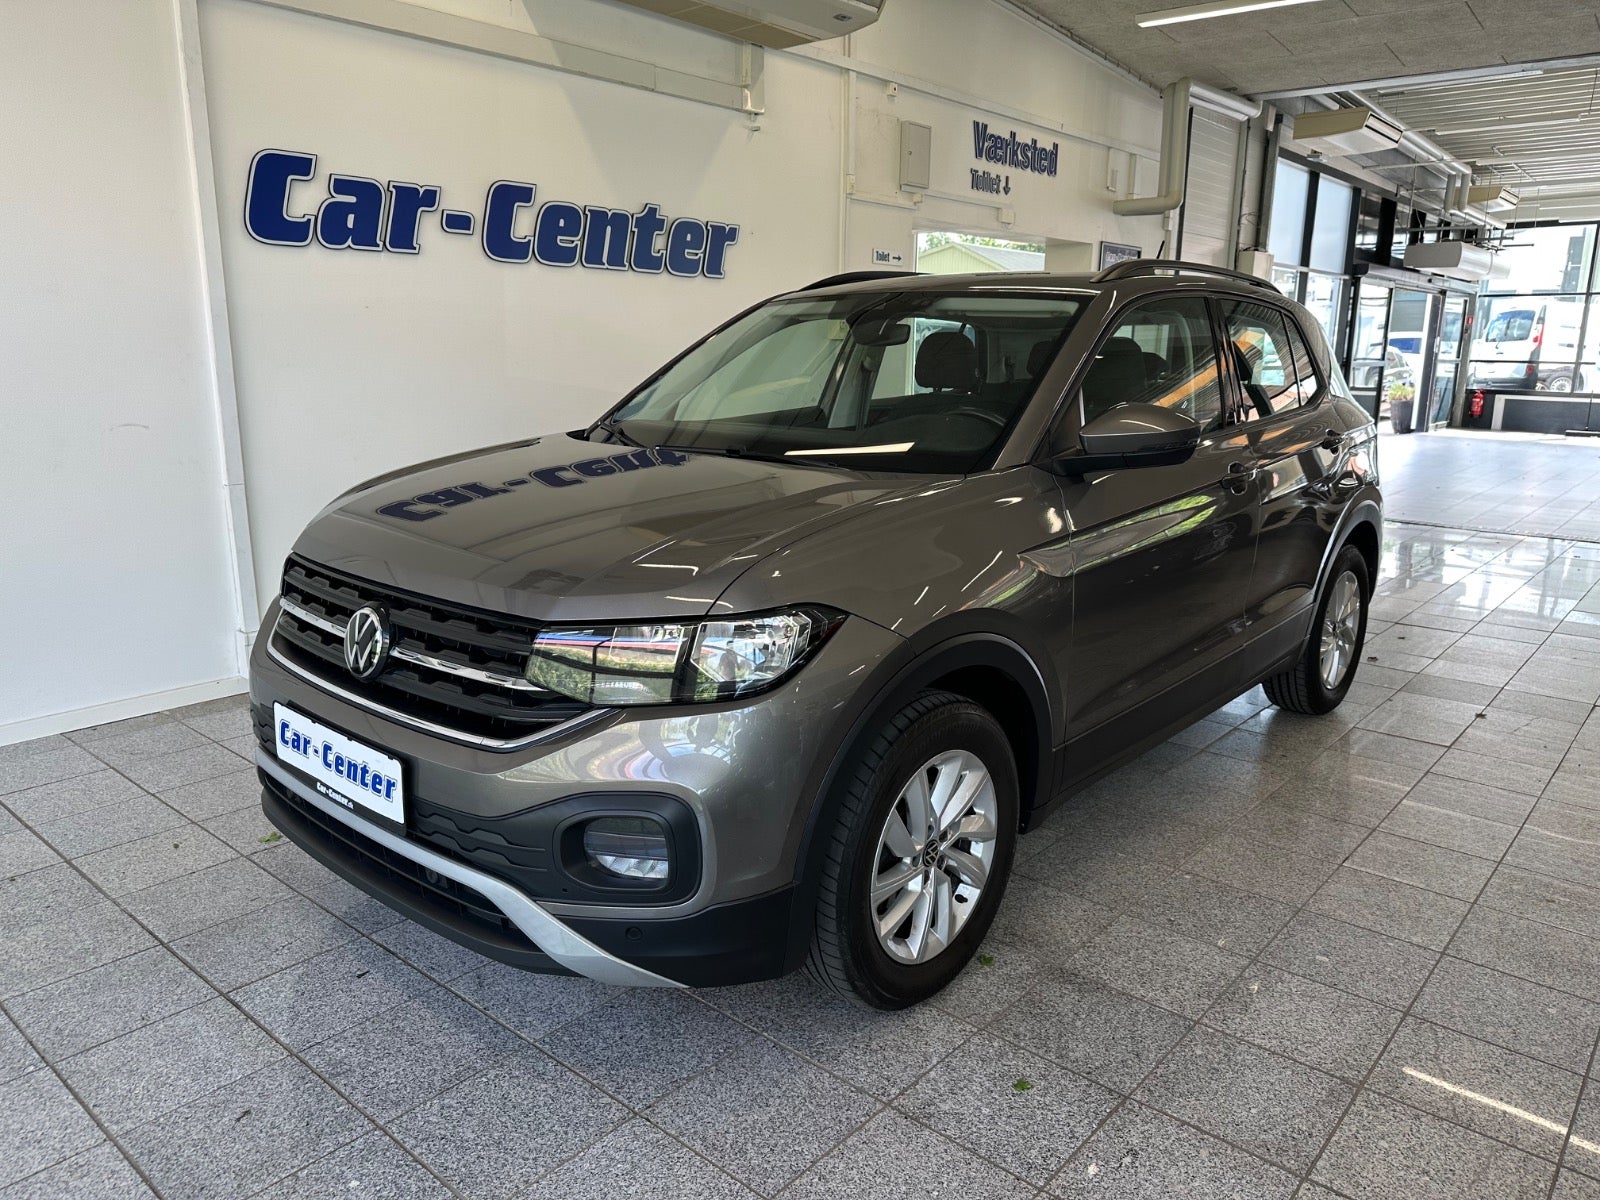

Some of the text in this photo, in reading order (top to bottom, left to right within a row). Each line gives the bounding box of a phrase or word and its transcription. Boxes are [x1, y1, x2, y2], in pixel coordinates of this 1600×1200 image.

[973, 120, 1059, 177] Værksted
[970, 168, 1002, 194] Toilet
[244, 148, 741, 279] Car-Center
[875, 250, 890, 263] Toilet
[279, 718, 397, 803] Car-Center
